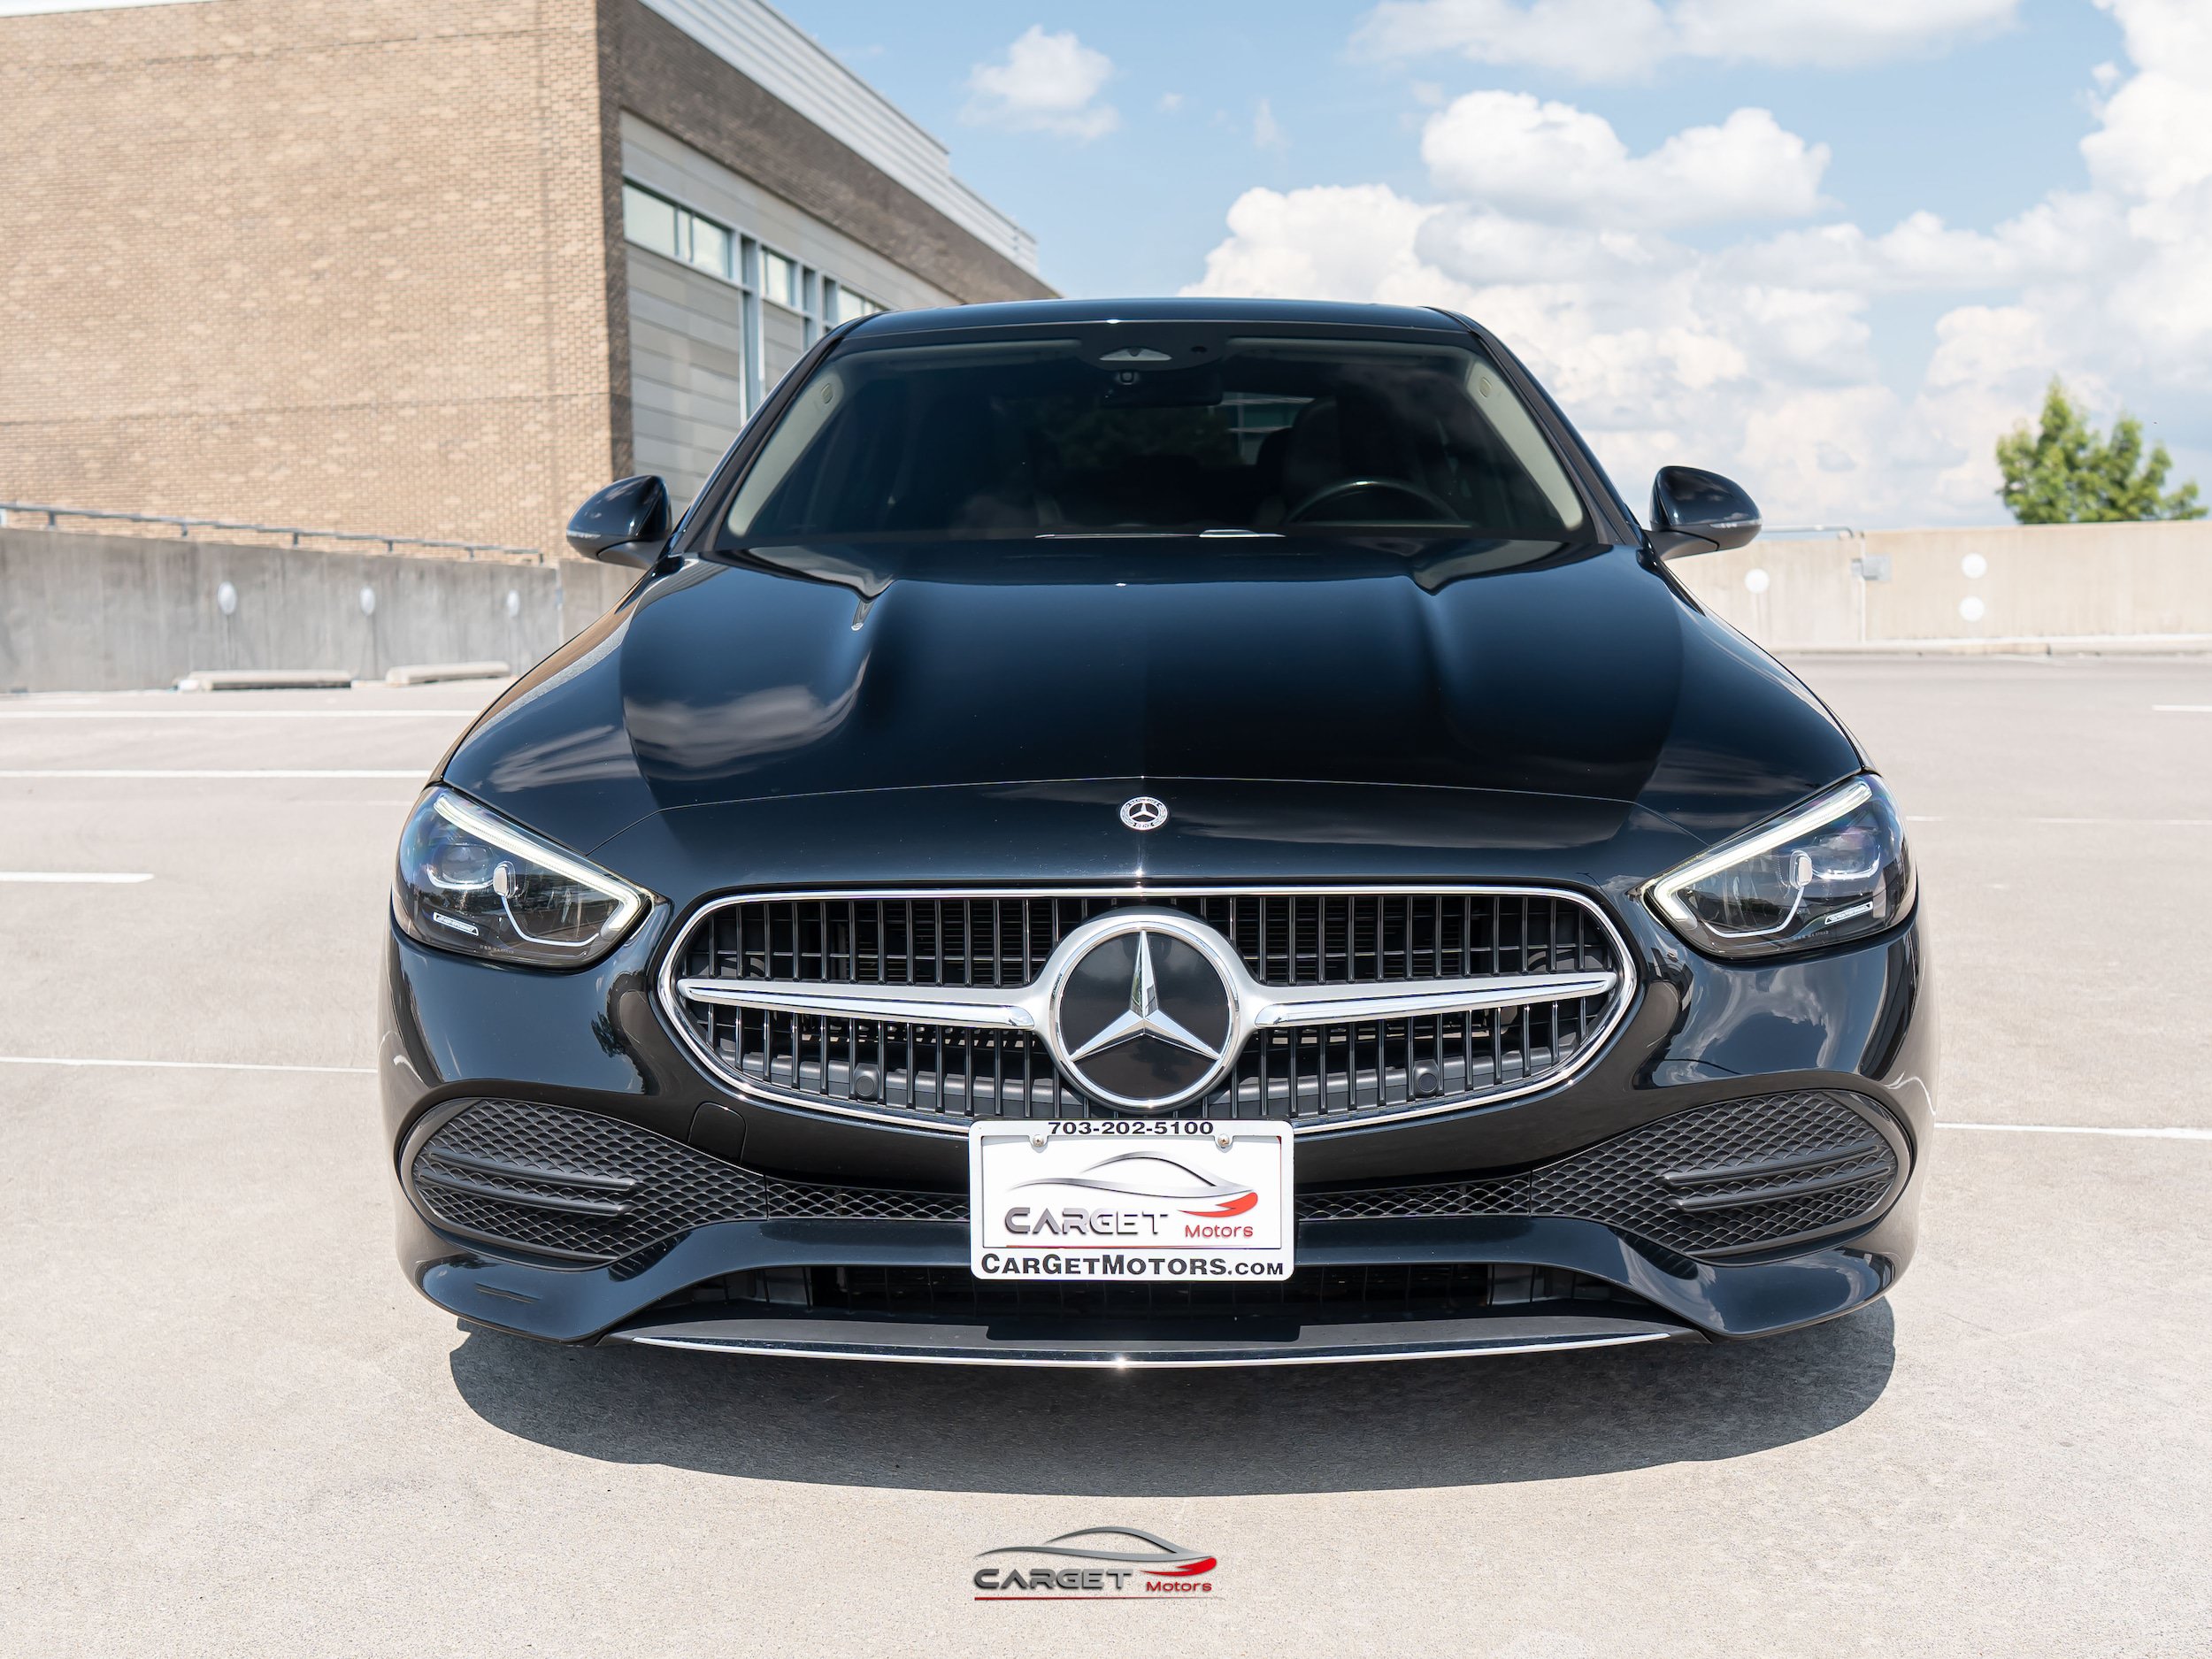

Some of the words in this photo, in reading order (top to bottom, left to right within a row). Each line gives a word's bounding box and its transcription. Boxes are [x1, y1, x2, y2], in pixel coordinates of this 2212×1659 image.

[1048, 1121, 1214, 1135] 703-202-5100
[1004, 1207, 1169, 1235] CARGET
[1185, 1225, 1254, 1238] Motors
